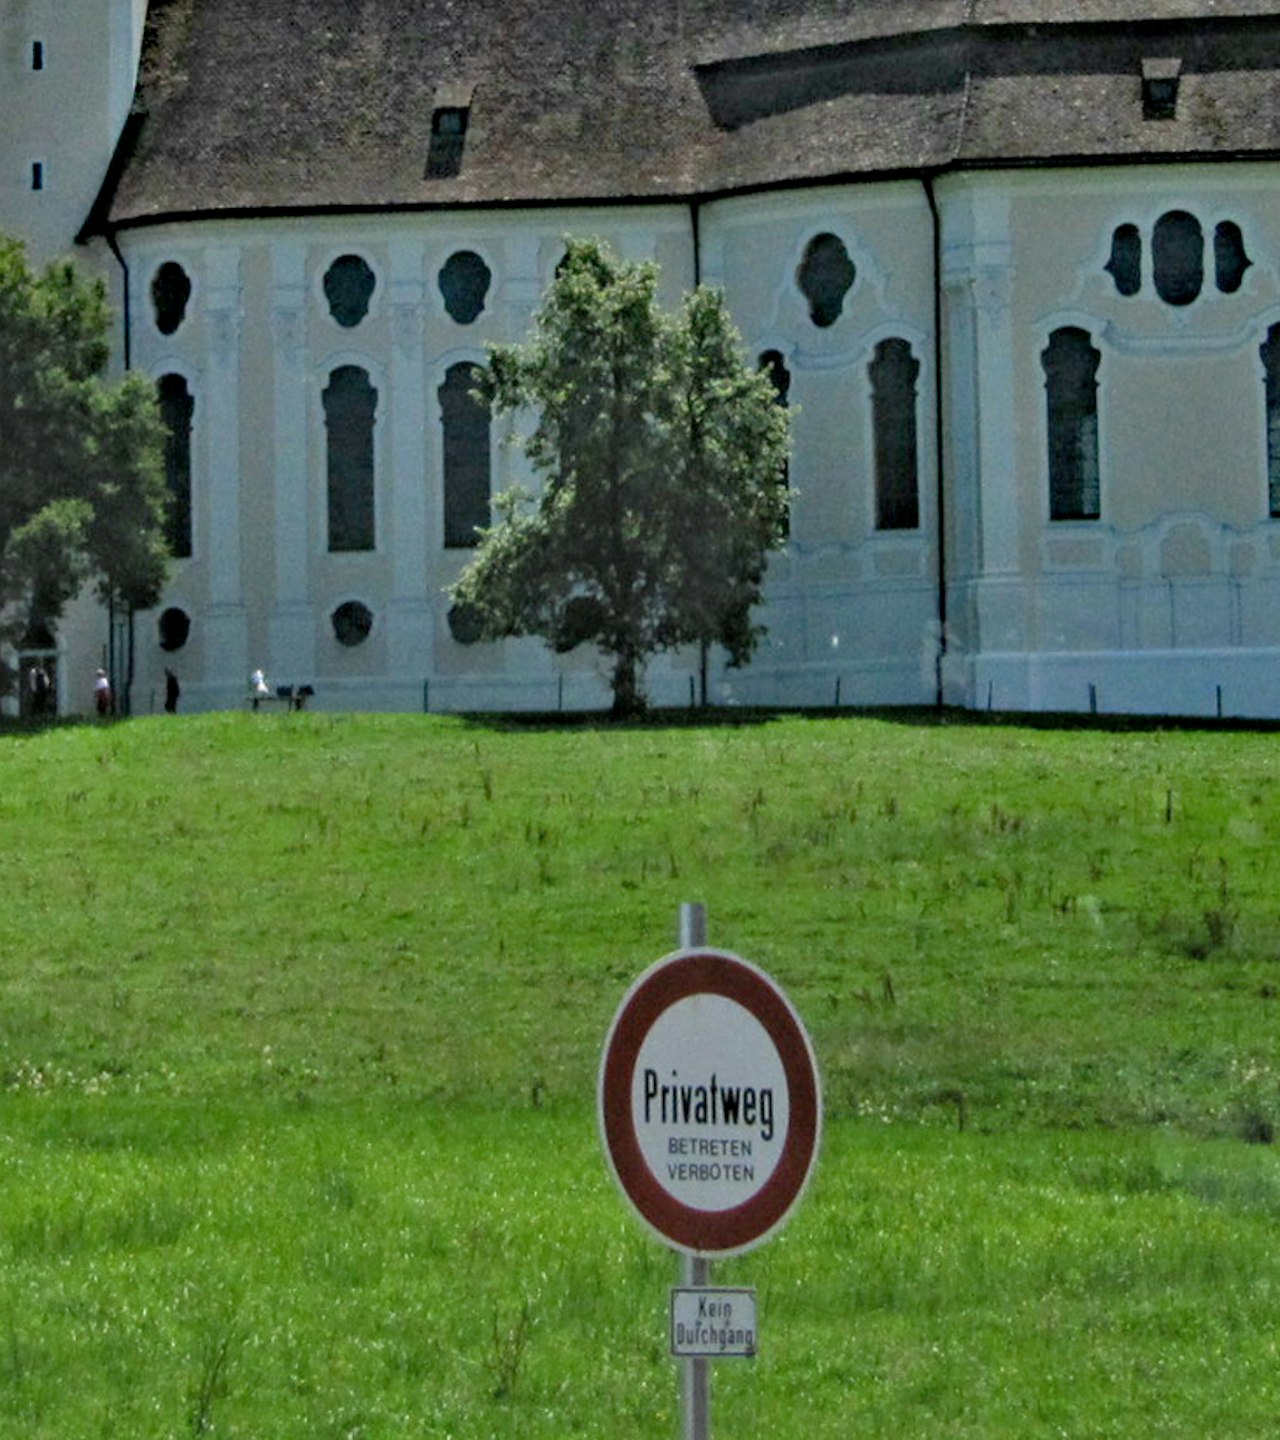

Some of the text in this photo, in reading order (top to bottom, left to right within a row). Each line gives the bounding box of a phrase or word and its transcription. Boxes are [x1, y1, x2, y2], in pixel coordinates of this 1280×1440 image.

[644, 1068, 774, 1141] Privatweg
[668, 1137, 753, 1157] BETRETEN
[667, 1163, 755, 1181] VERBOTEN
[698, 1296, 733, 1318] Kein
[676, 1323, 754, 1351] Durchgang
